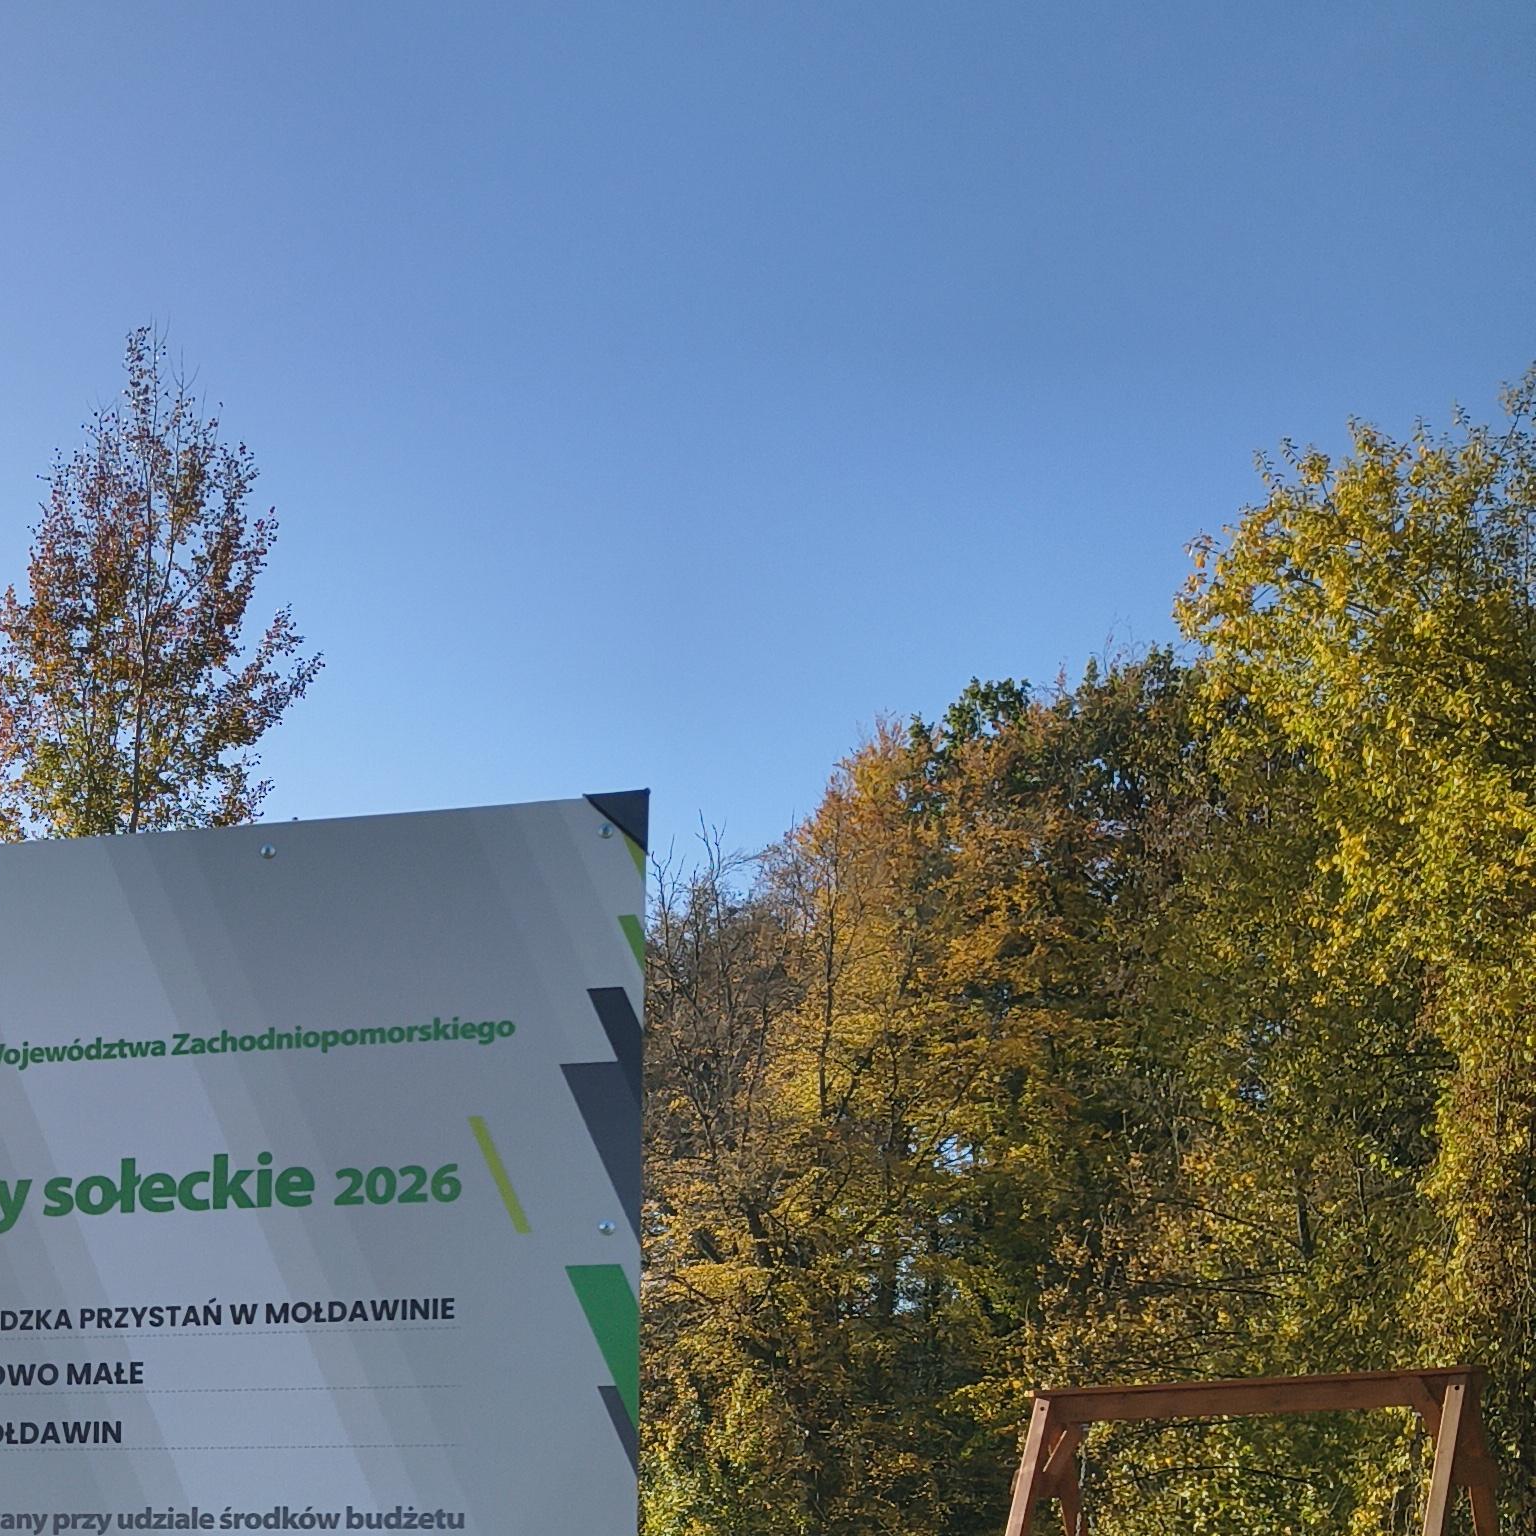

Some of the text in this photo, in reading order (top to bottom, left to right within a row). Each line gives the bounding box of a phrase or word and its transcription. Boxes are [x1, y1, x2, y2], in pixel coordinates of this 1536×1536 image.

[171, 1017, 516, 1056] Zachodniopomorskiego
[43, 1152, 315, 1217] sołeckie
[334, 1164, 461, 1205] 2026
[80, 1298, 221, 1329] PRZYSTAŃ
[230, 1304, 258, 1325] W
[266, 1298, 455, 1324] MOŁDAWINIE
[67, 1362, 143, 1385] MAŁE
[53, 1514, 112, 1535] przy
[118, 1507, 214, 1529] udziale
[220, 1506, 340, 1529] środków
[346, 1506, 464, 1529] budżetu
